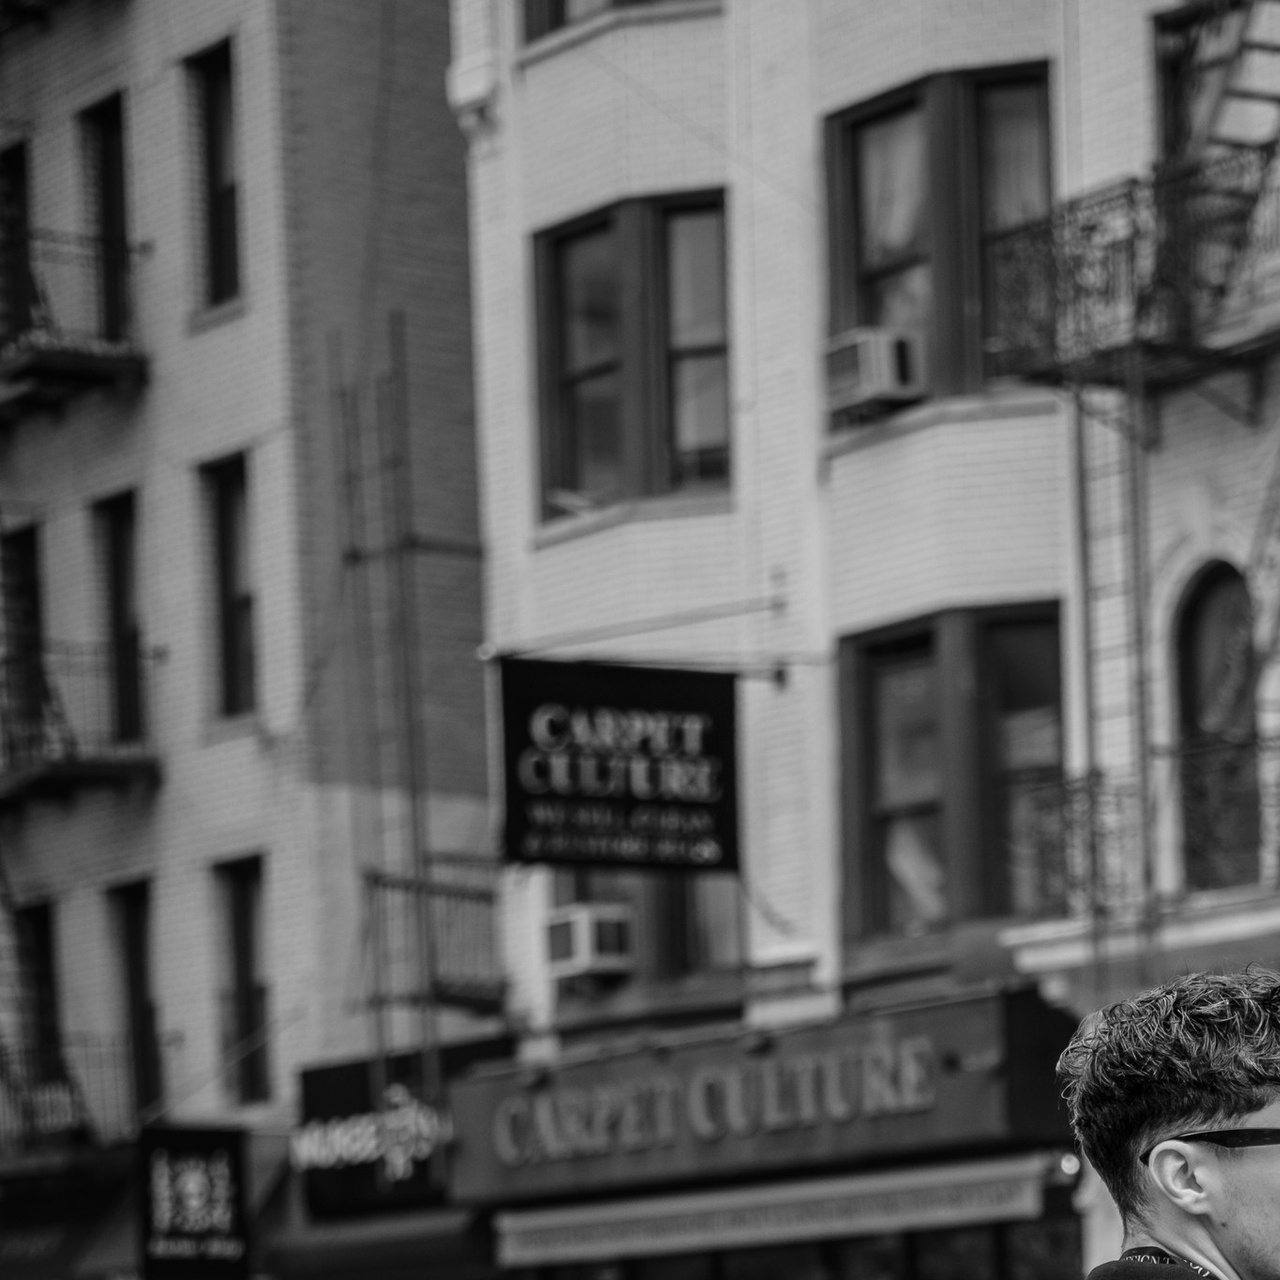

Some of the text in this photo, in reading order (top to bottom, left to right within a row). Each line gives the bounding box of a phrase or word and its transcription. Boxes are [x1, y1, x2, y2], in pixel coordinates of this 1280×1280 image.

[518, 750, 723, 801] CULTURE
[495, 1074, 682, 1166] CARPET
[688, 1034, 935, 1138] CULTURE
